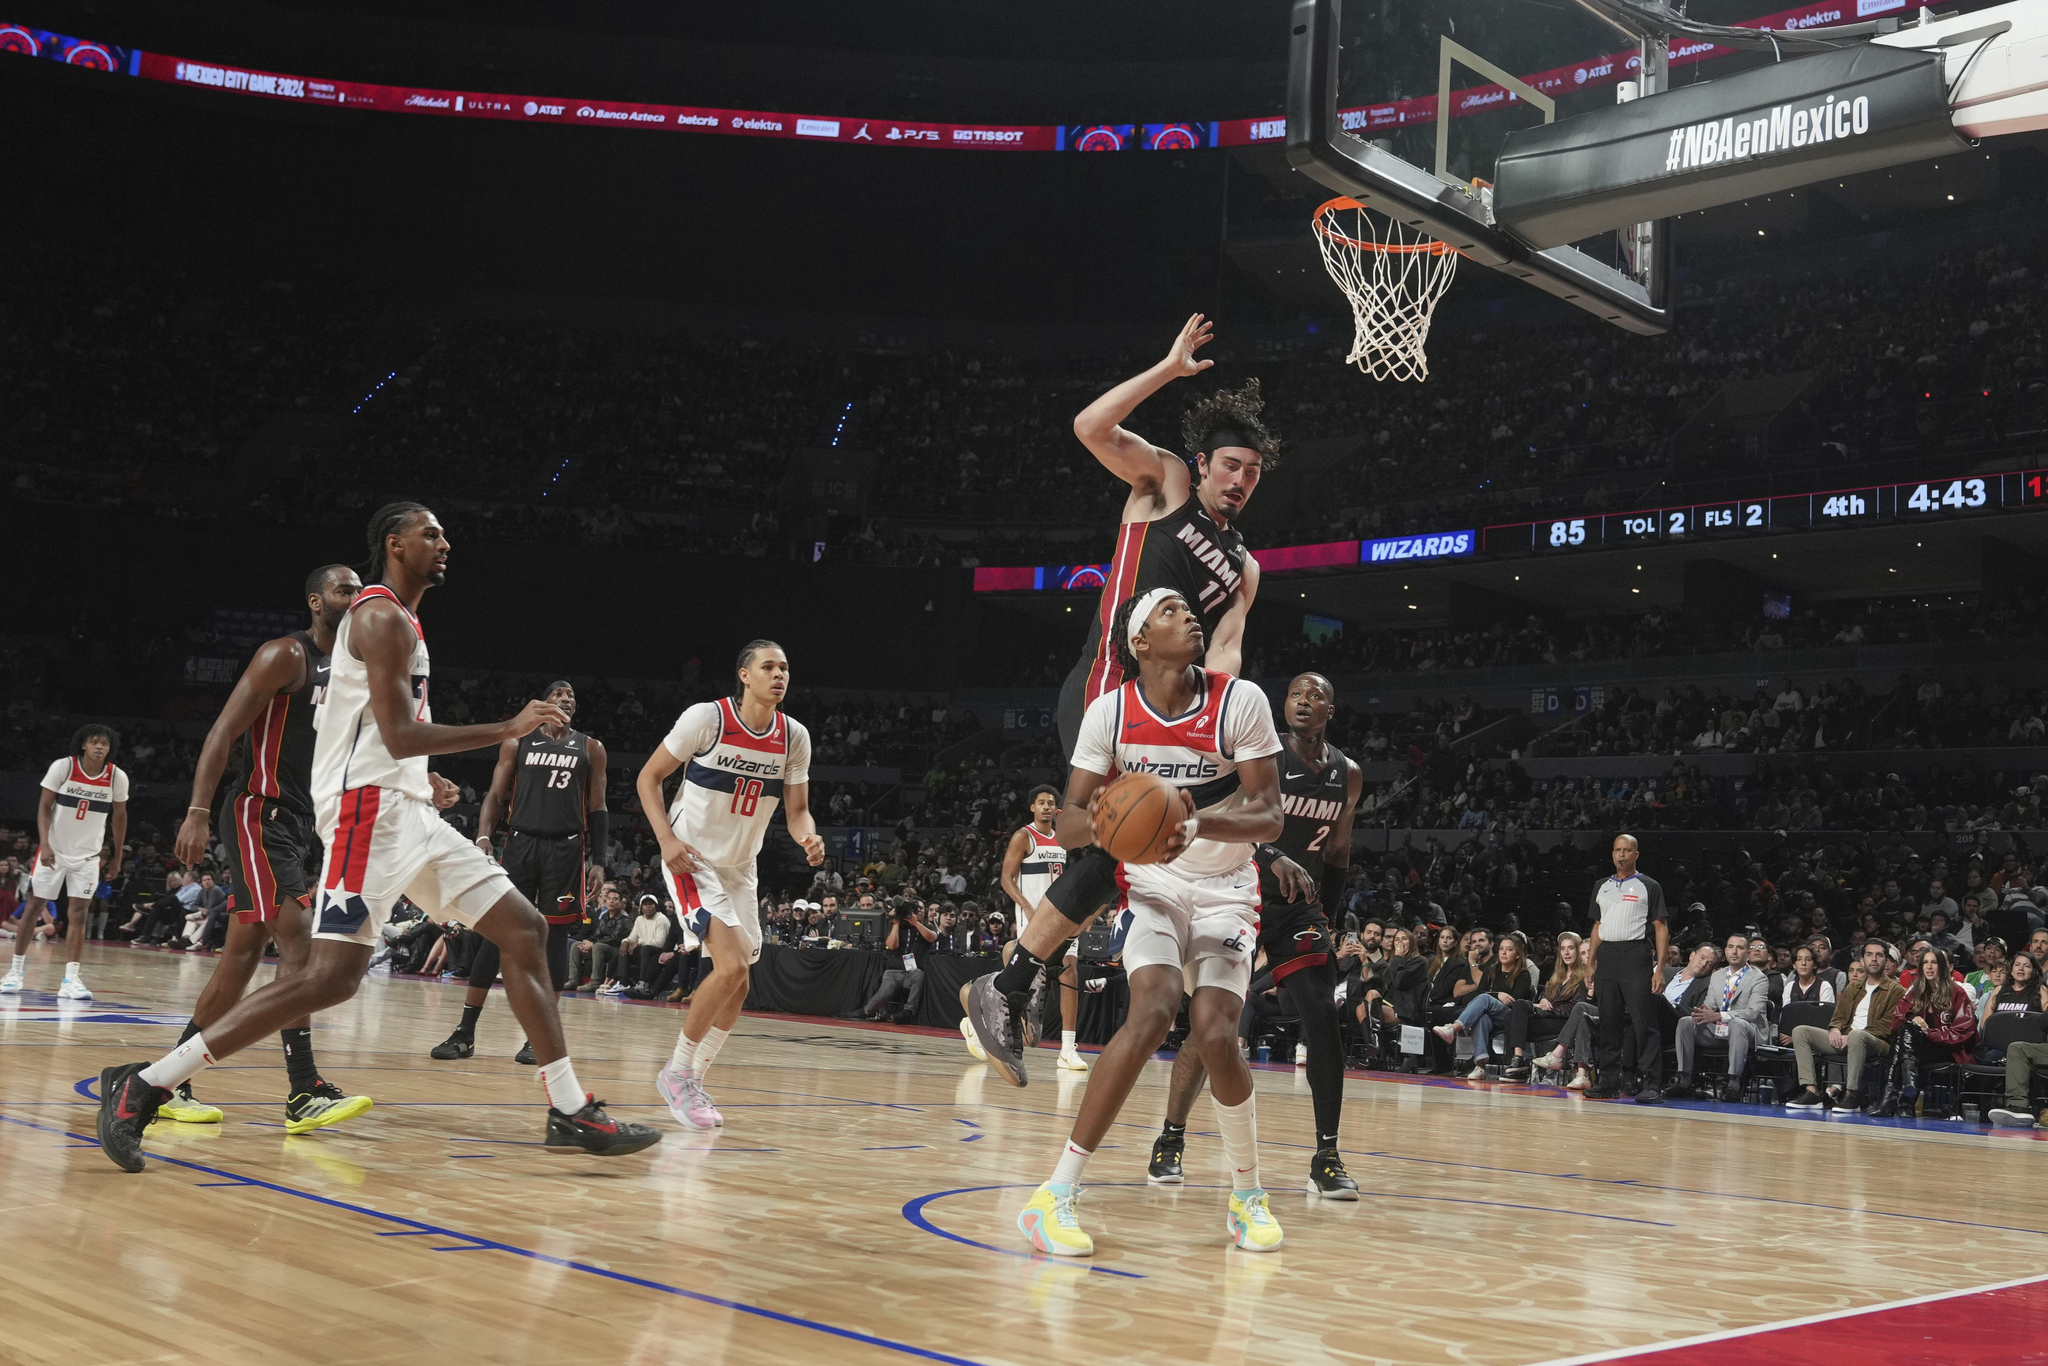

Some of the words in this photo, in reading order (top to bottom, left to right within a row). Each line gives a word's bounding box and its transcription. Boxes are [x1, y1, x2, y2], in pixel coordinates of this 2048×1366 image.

[1799, 10, 1841, 28] elektra
[1677, 43, 1714, 57] Azteca
[1588, 63, 1614, 78] AT&T
[185, 63, 224, 87] MEXICO
[225, 69, 249, 90] CITY
[248, 73, 277, 94] GAME
[277, 77, 304, 98] 2024
[468, 101, 511, 111] ULTRA
[538, 105, 566, 116] AT&T
[595, 109, 628, 120] Banco
[629, 111, 665, 123] Azteca
[678, 114, 719, 127] betcris
[1258, 119, 1286, 139] MEXIC
[1342, 110, 1367, 130] 2024
[744, 118, 782, 132] elektra
[801, 121, 835, 133] Emirates
[1665, 95, 1869, 171] #NBAenMexico
[904, 129, 940, 141] PS5
[973, 130, 1024, 141] TISSOT
[1550, 520, 1585, 546] 85
[1624, 518, 1655, 535] TOL
[1669, 512, 1685, 534] 2
[1705, 510, 1732, 527] FLS
[1746, 505, 1762, 526] 2
[1822, 495, 1865, 517] 4th
[1908, 478, 1987, 513] 4:43
[2028, 475, 2048, 498] 1
[1371, 534, 1469, 561] WIZARDS
[1176, 522, 1242, 594] MIAMI
[1198, 580, 1227, 614] 11
[1547, 695, 1559, 711] D
[1575, 695, 1587, 711] D
[1186, 731, 1214, 739] Robinhood
[525, 752, 578, 769] MIAMI
[717, 754, 782, 776] wizards
[1122, 755, 1220, 779] wizards
[547, 770, 572, 789] 13
[67, 787, 109, 800] wizards
[730, 777, 764, 818] 18
[76, 800, 89, 821] 8
[1281, 793, 1342, 821] MIAMI
[852, 831, 861, 854] 1
[1307, 825, 1330, 851] 2
[1956, 834, 1974, 844] 205
[1997, 1002, 2028, 1011] MIAMI
